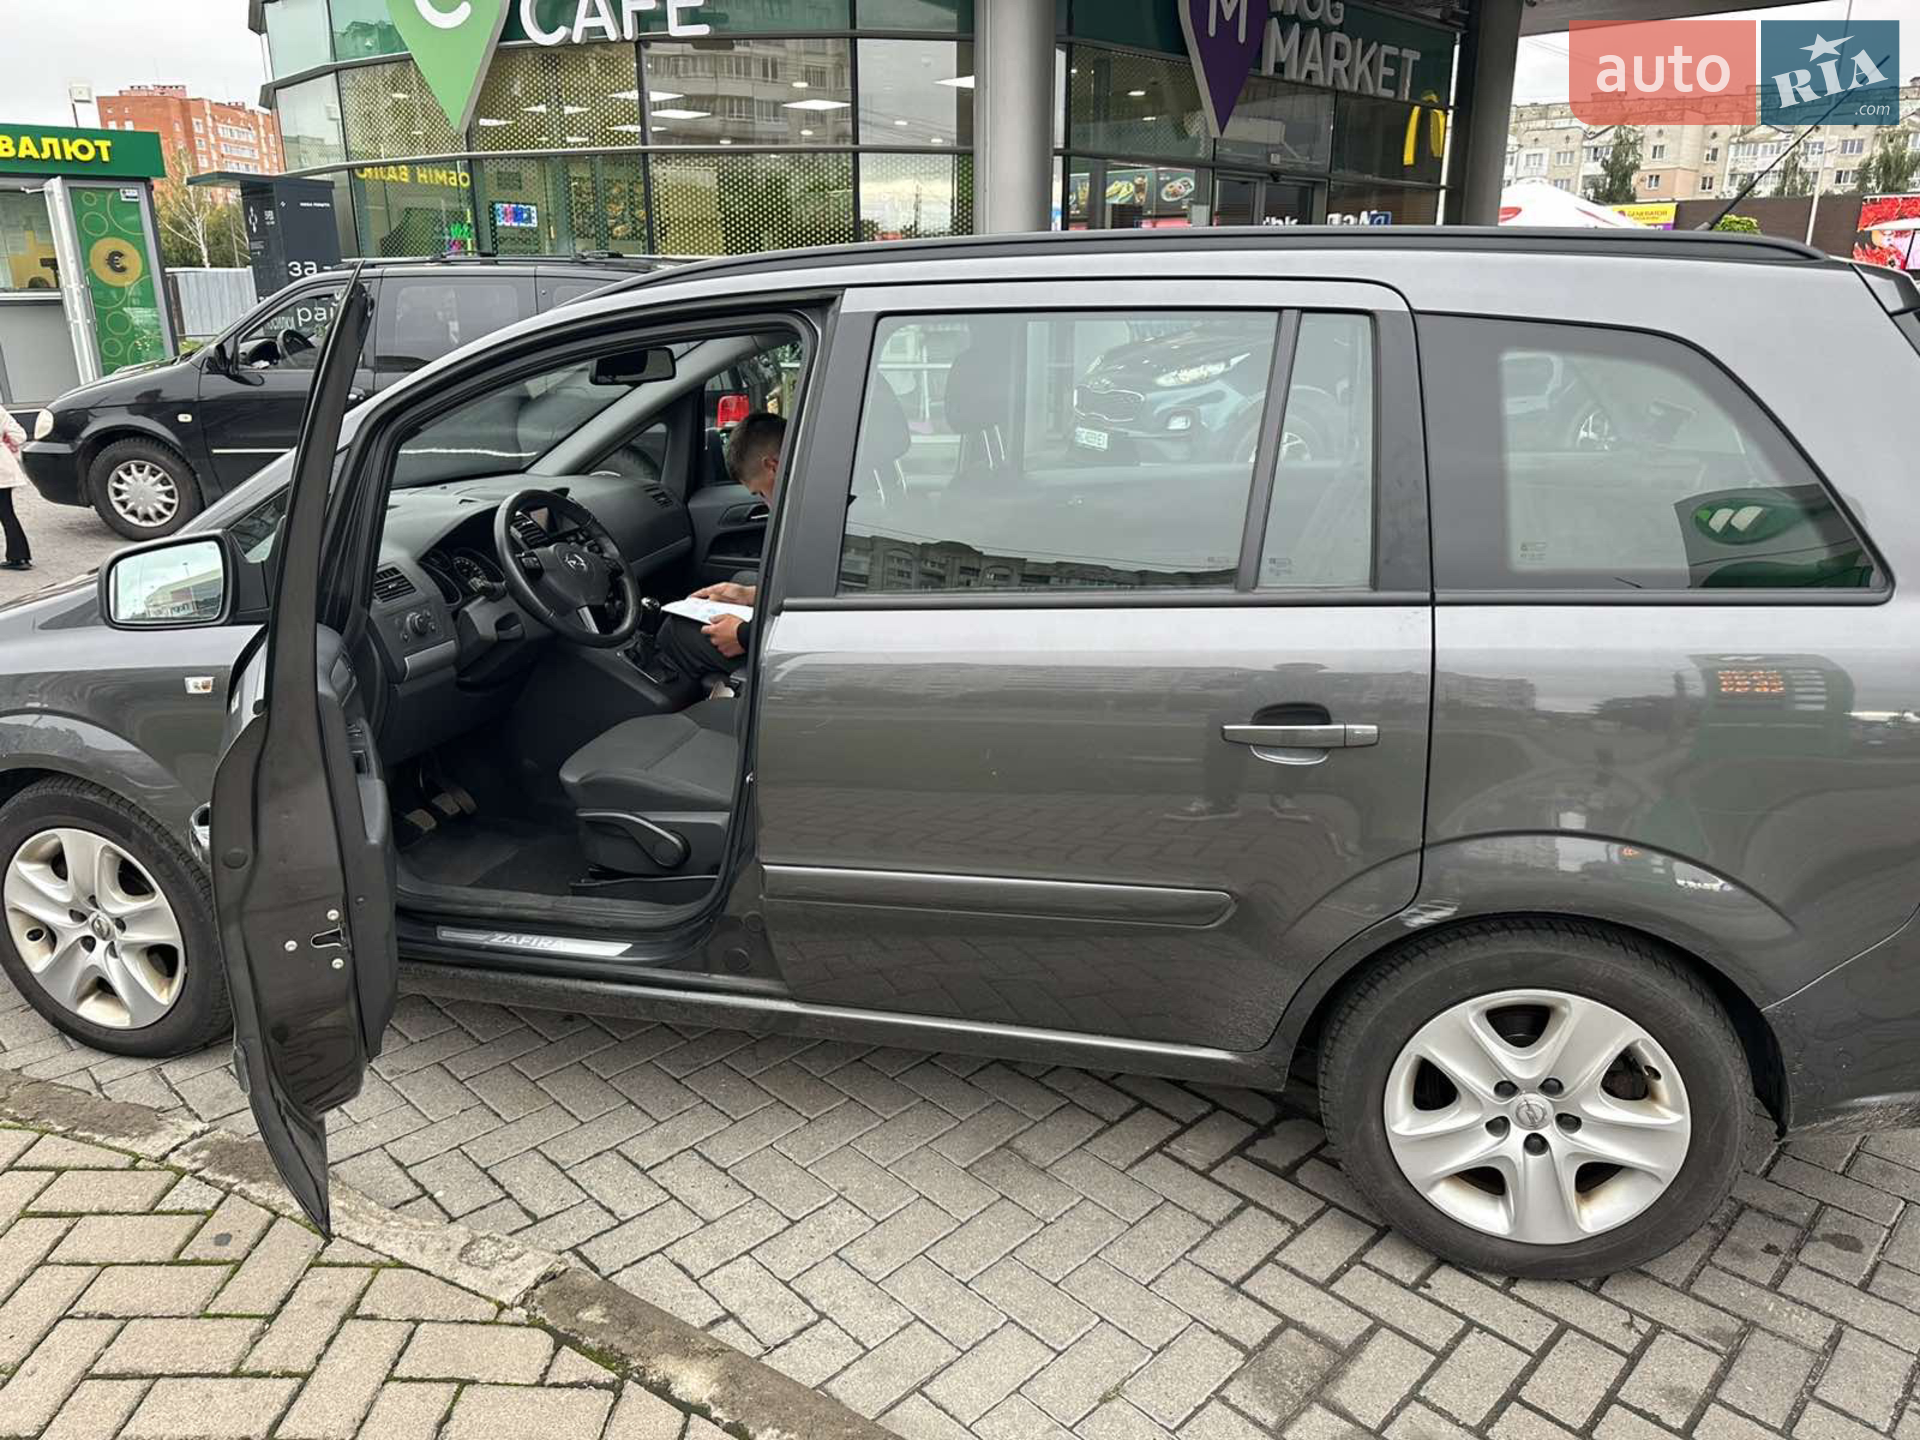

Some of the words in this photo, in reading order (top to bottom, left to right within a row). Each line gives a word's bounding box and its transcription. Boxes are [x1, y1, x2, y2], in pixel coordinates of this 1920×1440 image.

[519, 0, 711, 46] CAFE
[1262, 17, 1421, 101] MARKET
[0, 134, 112, 162] ВАЛЮТ
[489, 933, 566, 950] ZAFIRA
